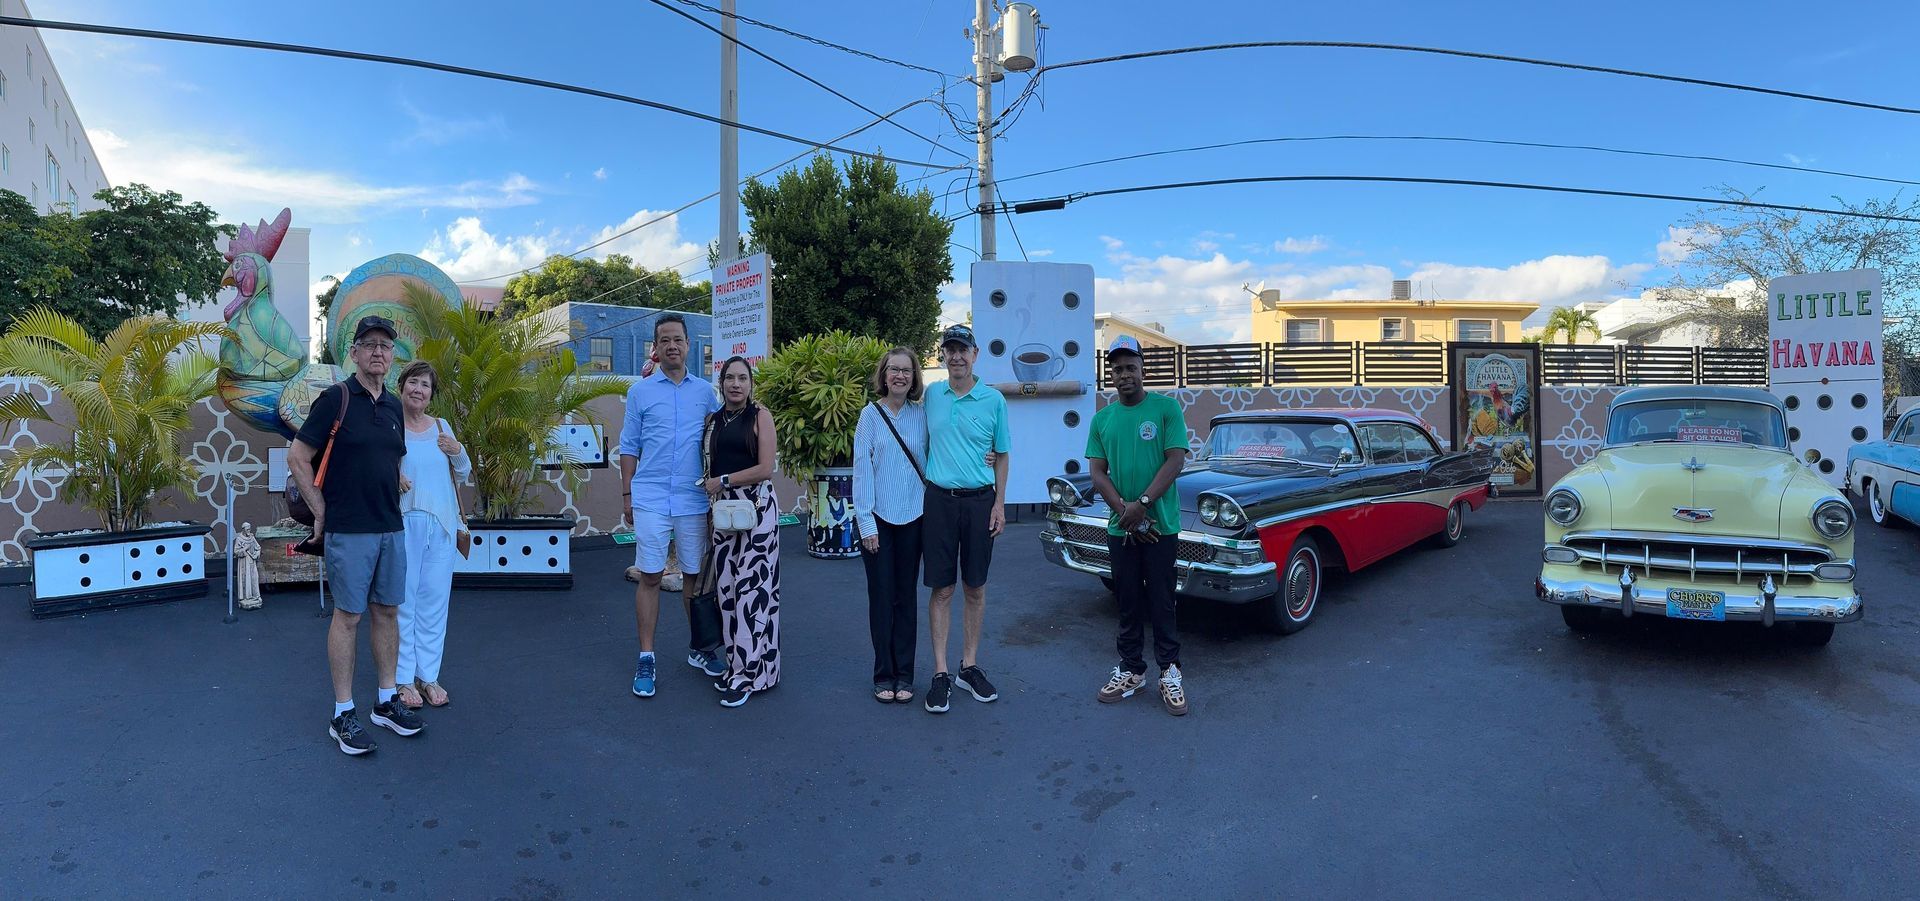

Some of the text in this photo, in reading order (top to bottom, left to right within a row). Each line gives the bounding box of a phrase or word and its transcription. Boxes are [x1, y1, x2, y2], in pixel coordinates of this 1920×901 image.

[727, 261, 749, 277] WARNING
[715, 273, 762, 296] PRIVATE PROPERTY
[1777, 290, 1872, 320] LITTLE
[732, 342, 747, 355] AVISO
[1772, 338, 1876, 368] HAVANA
[1484, 366, 1508, 374] LITTLE
[1678, 427, 1709, 435] PLEASE
[1723, 428, 1740, 436] NOT
[1670, 591, 1721, 604] CHURRO
